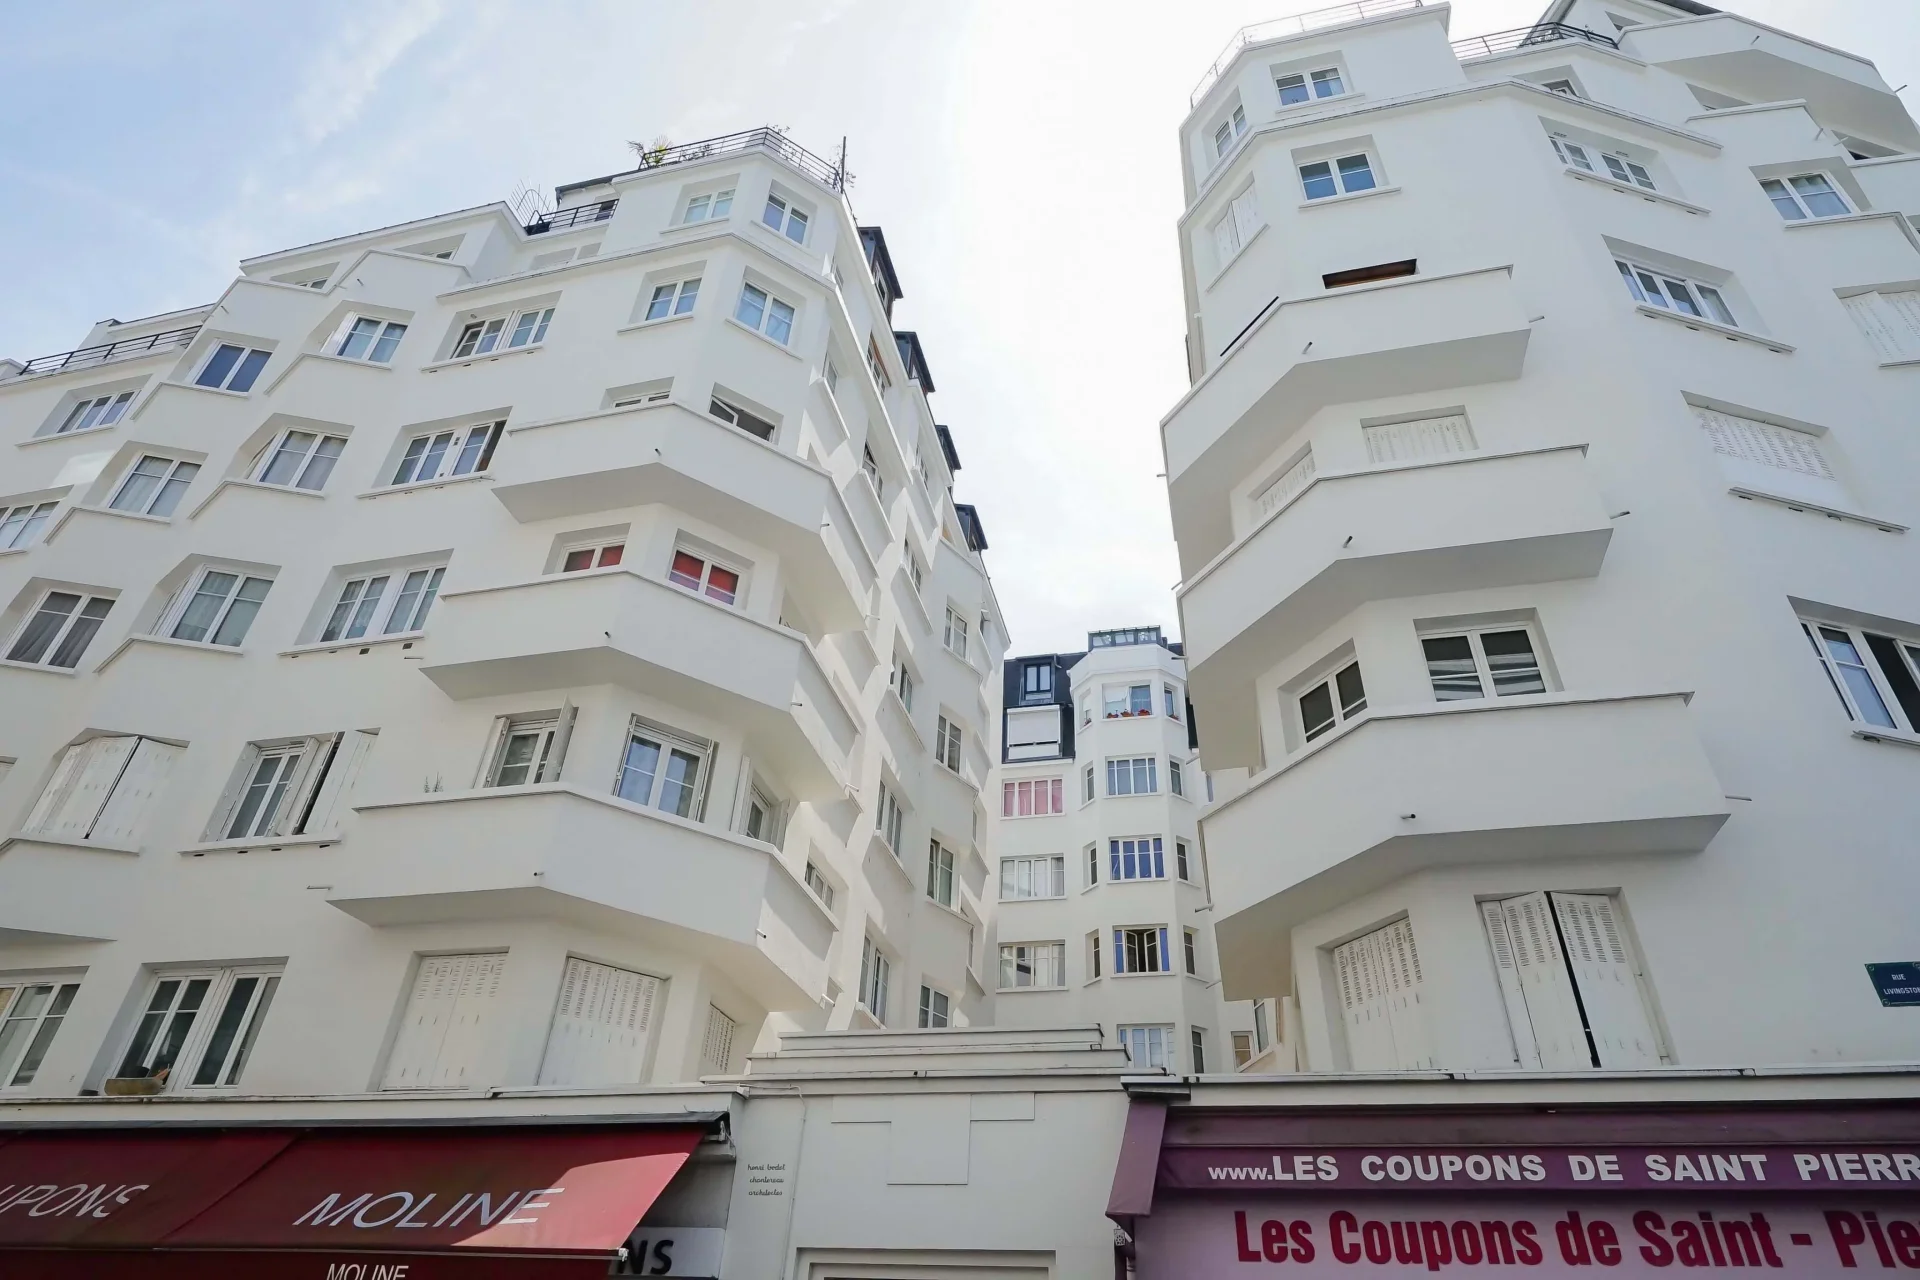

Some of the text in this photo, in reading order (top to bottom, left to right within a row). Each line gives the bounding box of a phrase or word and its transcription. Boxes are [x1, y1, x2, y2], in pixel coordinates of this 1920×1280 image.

[1891, 973, 1906, 981] RUE
[1208, 1153, 1920, 1181] www.LES COUPONS DE SAINT PIERR
[292, 1188, 566, 1228] MOLINE
[1234, 1210, 1315, 1263] Les
[1329, 1210, 1543, 1271] Coupons
[1555, 1210, 1622, 1266] de
[1633, 1210, 1784, 1267] Saint
